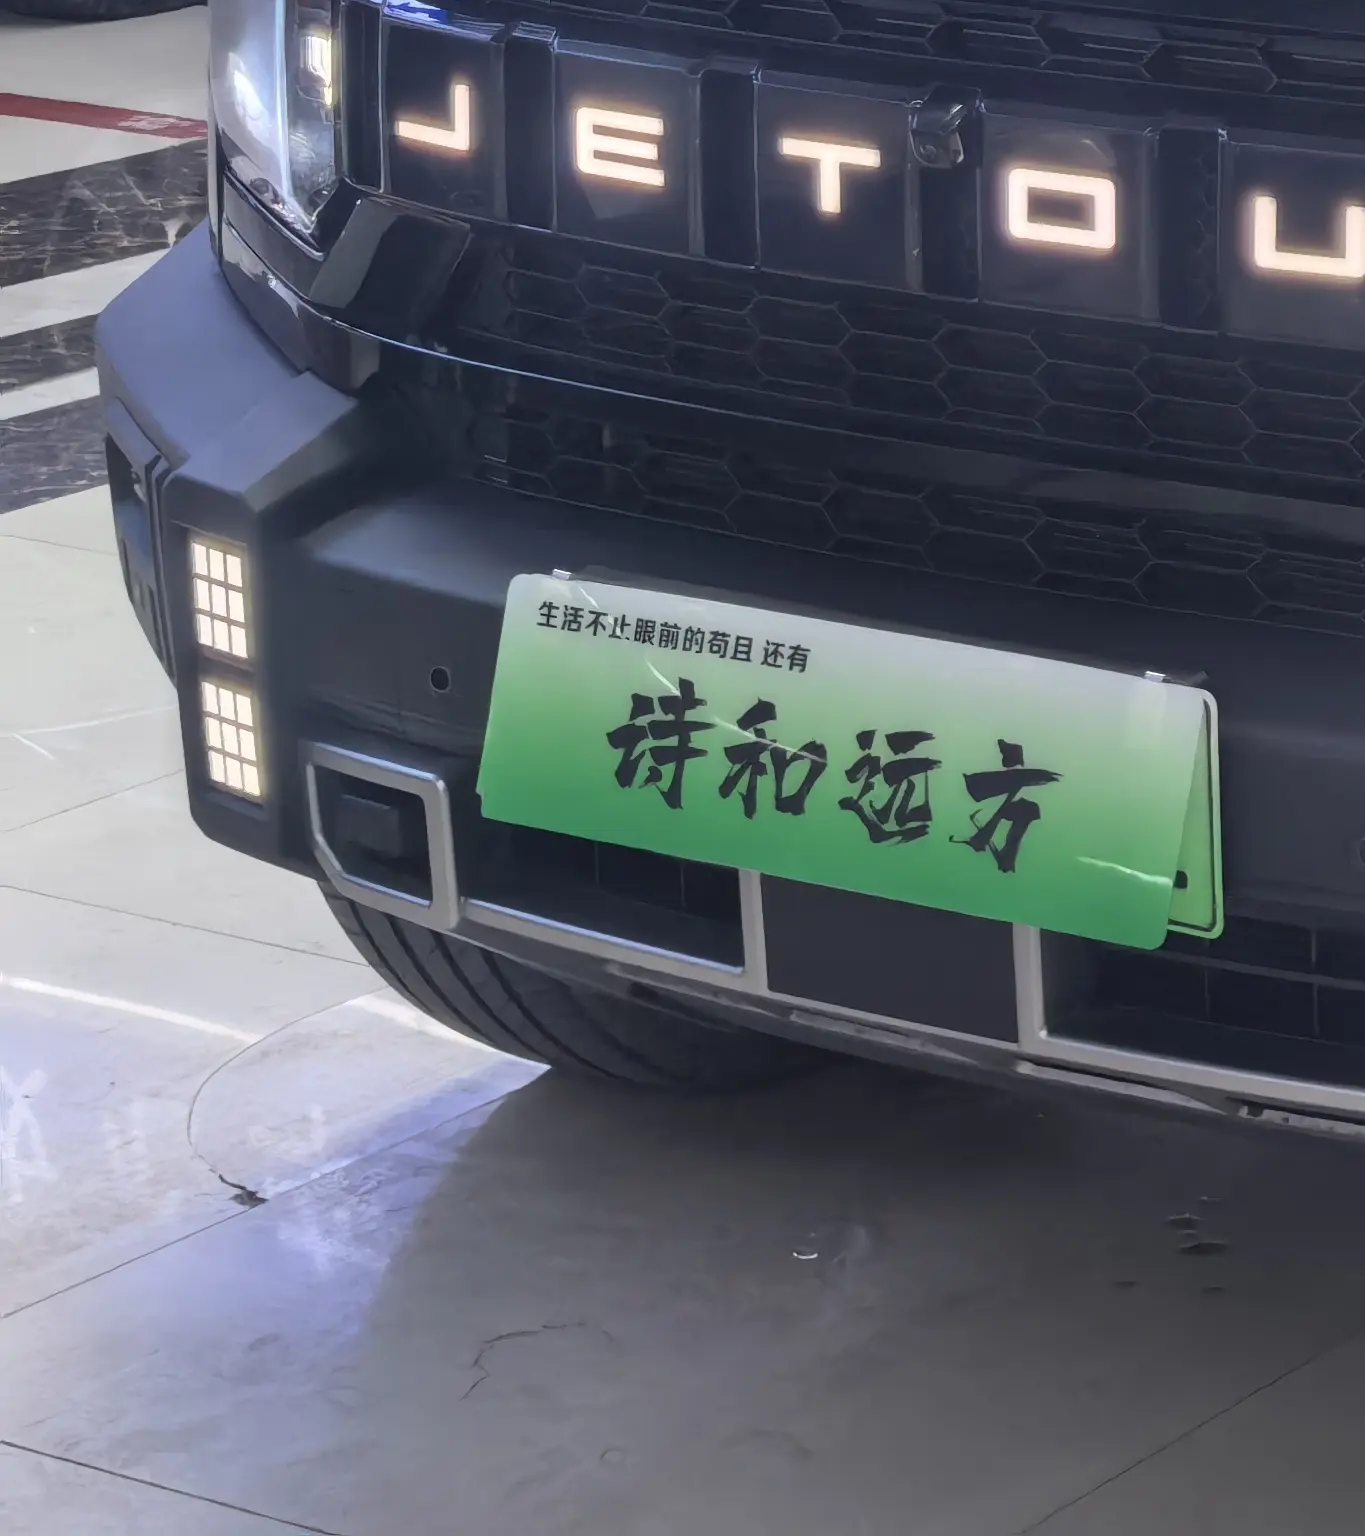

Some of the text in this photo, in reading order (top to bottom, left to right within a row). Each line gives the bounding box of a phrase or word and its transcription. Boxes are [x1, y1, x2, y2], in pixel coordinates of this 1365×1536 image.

[532, 600, 812, 674] 生活不止眼前的苟且 还有
[605, 676, 1064, 874] 诗和远方
